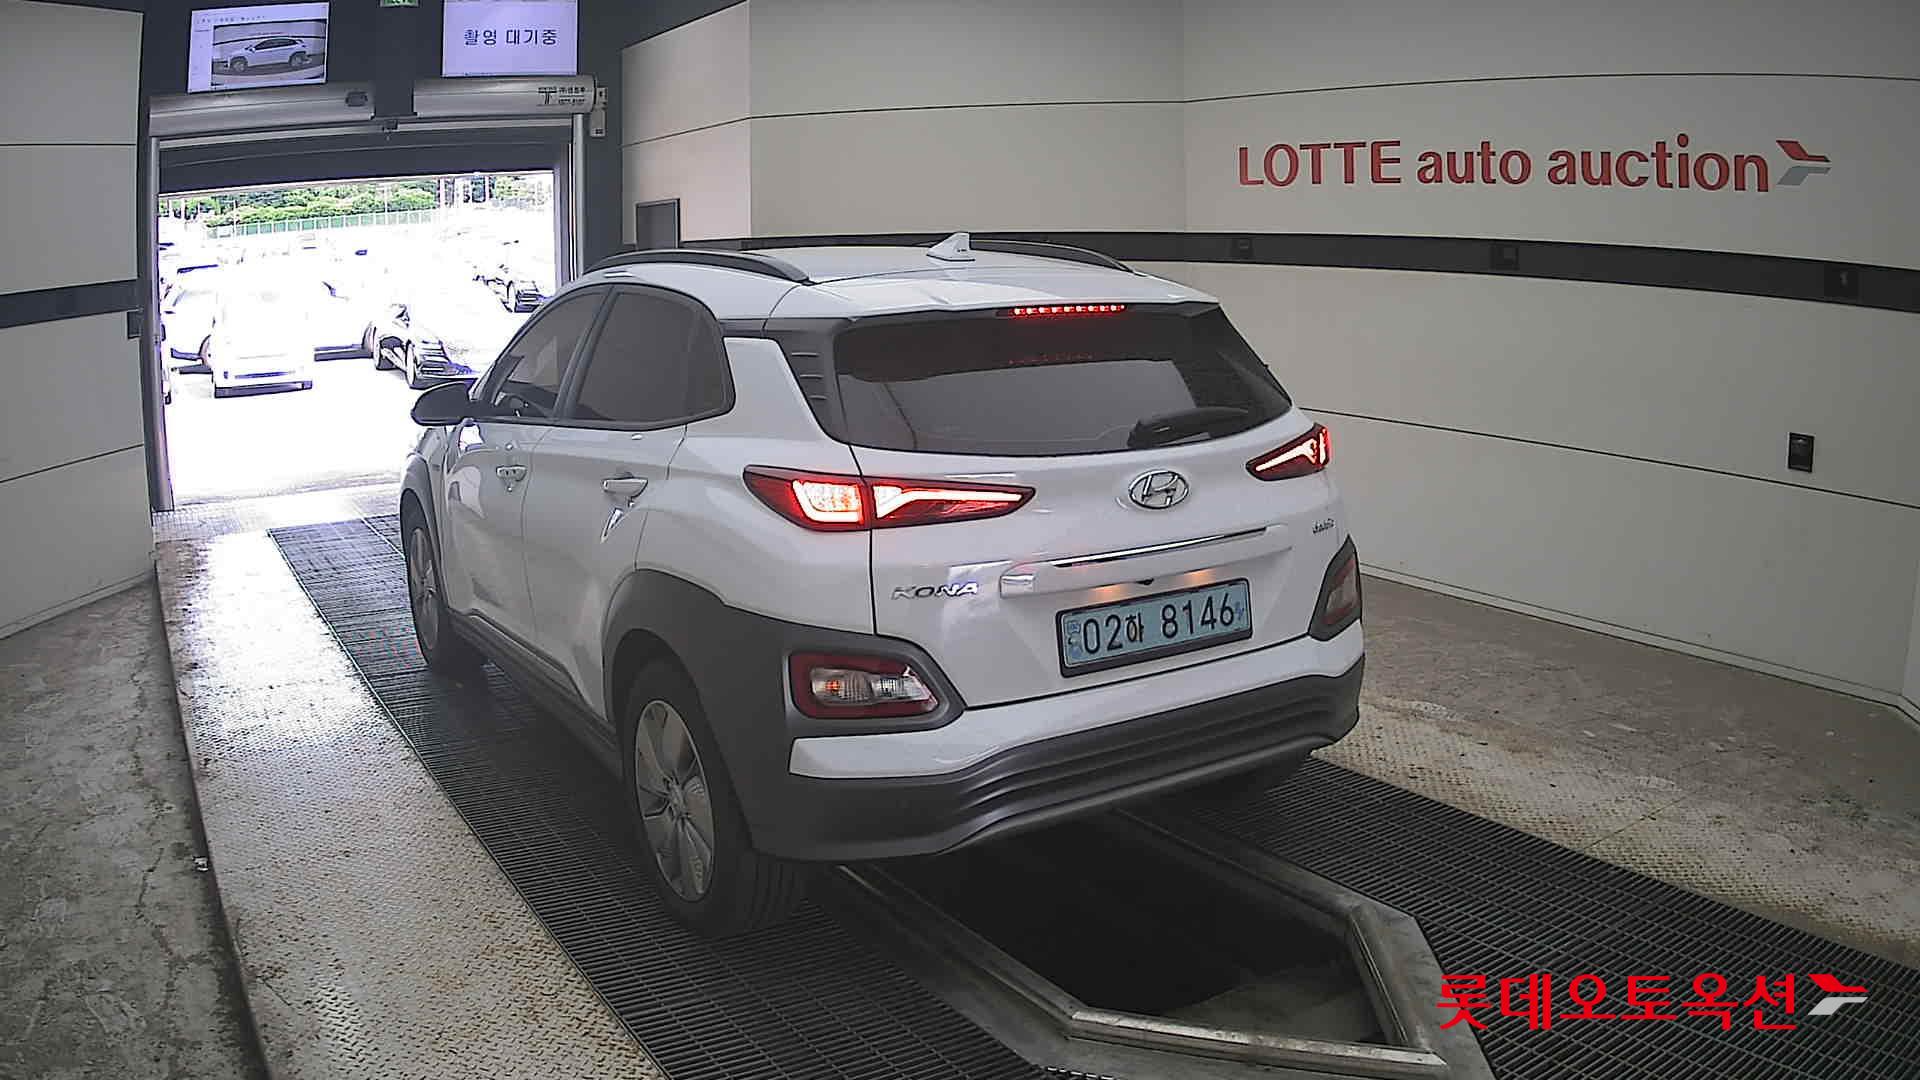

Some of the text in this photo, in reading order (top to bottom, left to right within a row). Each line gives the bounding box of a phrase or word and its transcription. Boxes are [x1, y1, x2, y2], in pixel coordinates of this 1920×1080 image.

[505, 28, 557, 46] 대기중
[1238, 133, 1770, 193] LOTTE auto auction
[891, 582, 979, 600] KONA
[1082, 592, 1235, 655] 02하 8146
